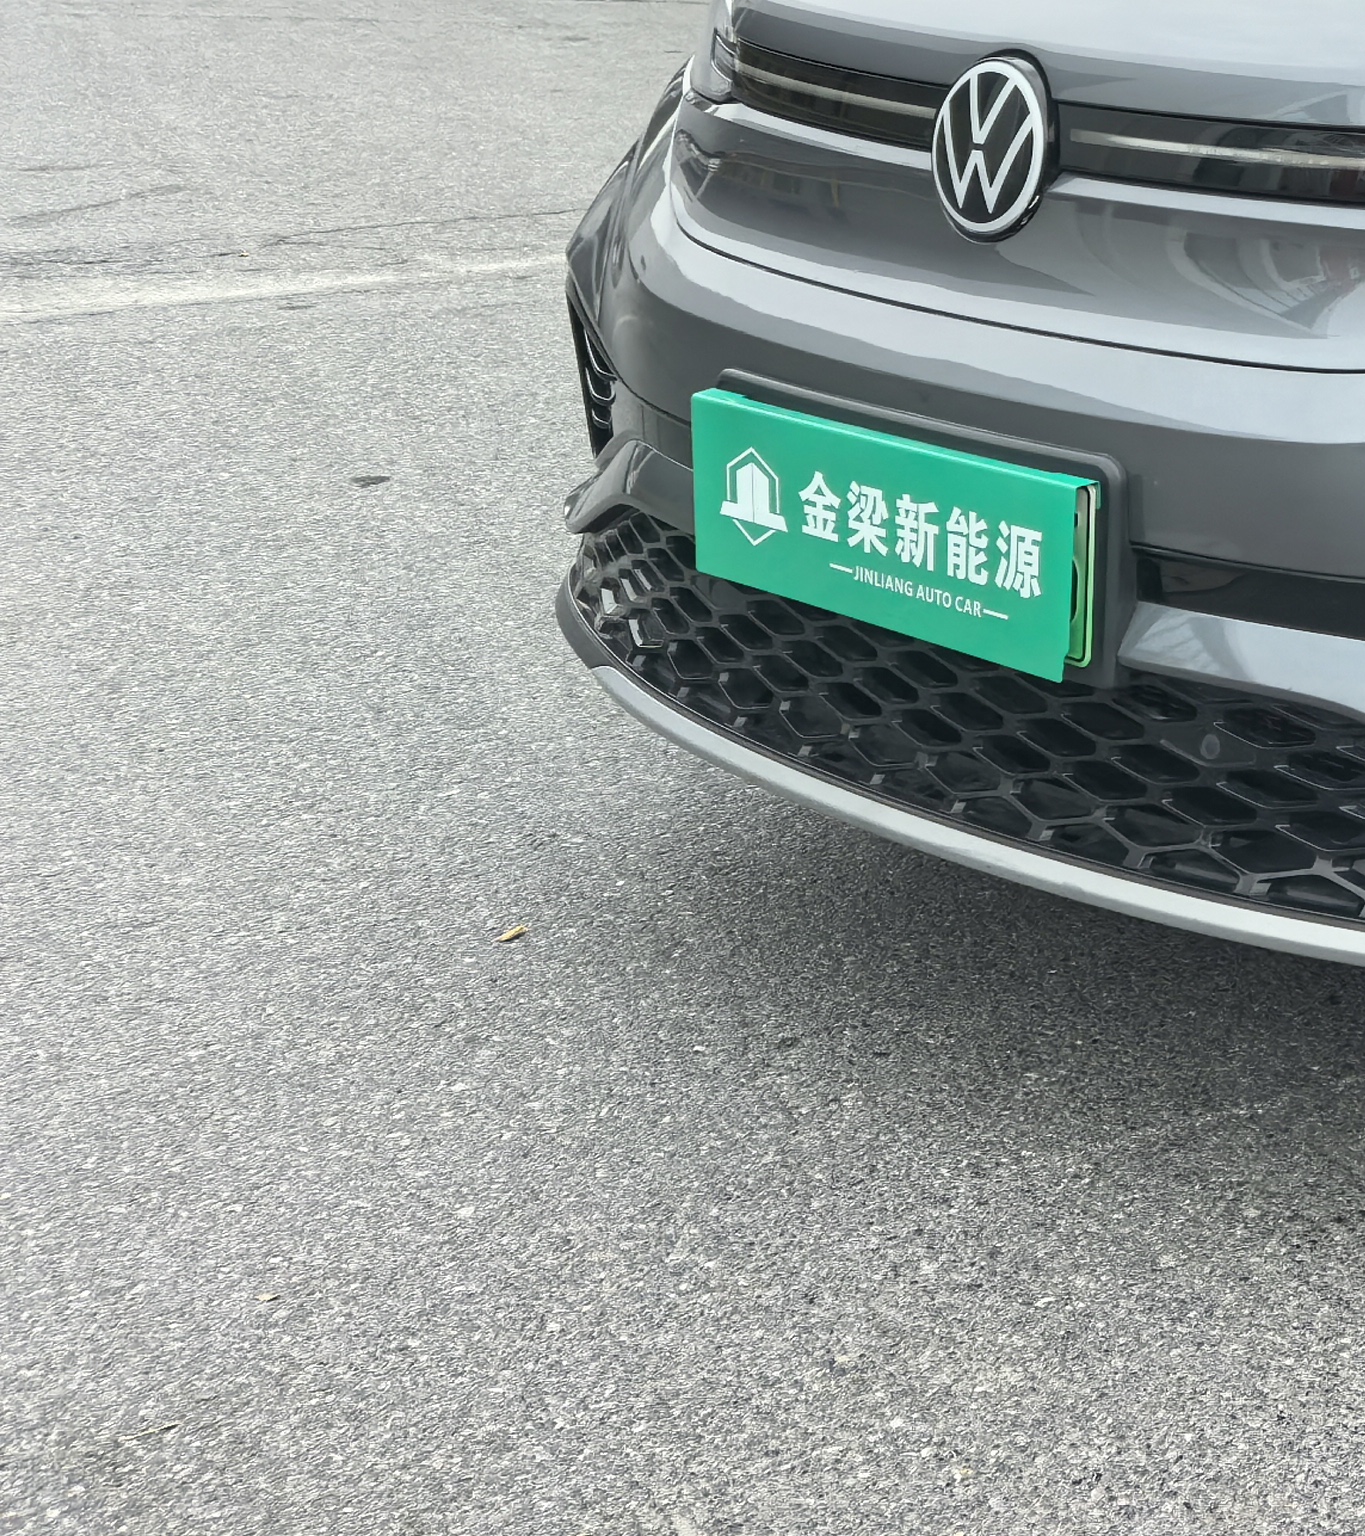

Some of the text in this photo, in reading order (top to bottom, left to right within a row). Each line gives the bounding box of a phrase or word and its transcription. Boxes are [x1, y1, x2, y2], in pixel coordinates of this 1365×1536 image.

[797, 470, 1045, 600] 金梁新能源
[853, 564, 983, 618] JINLIANG AUTO CAR
